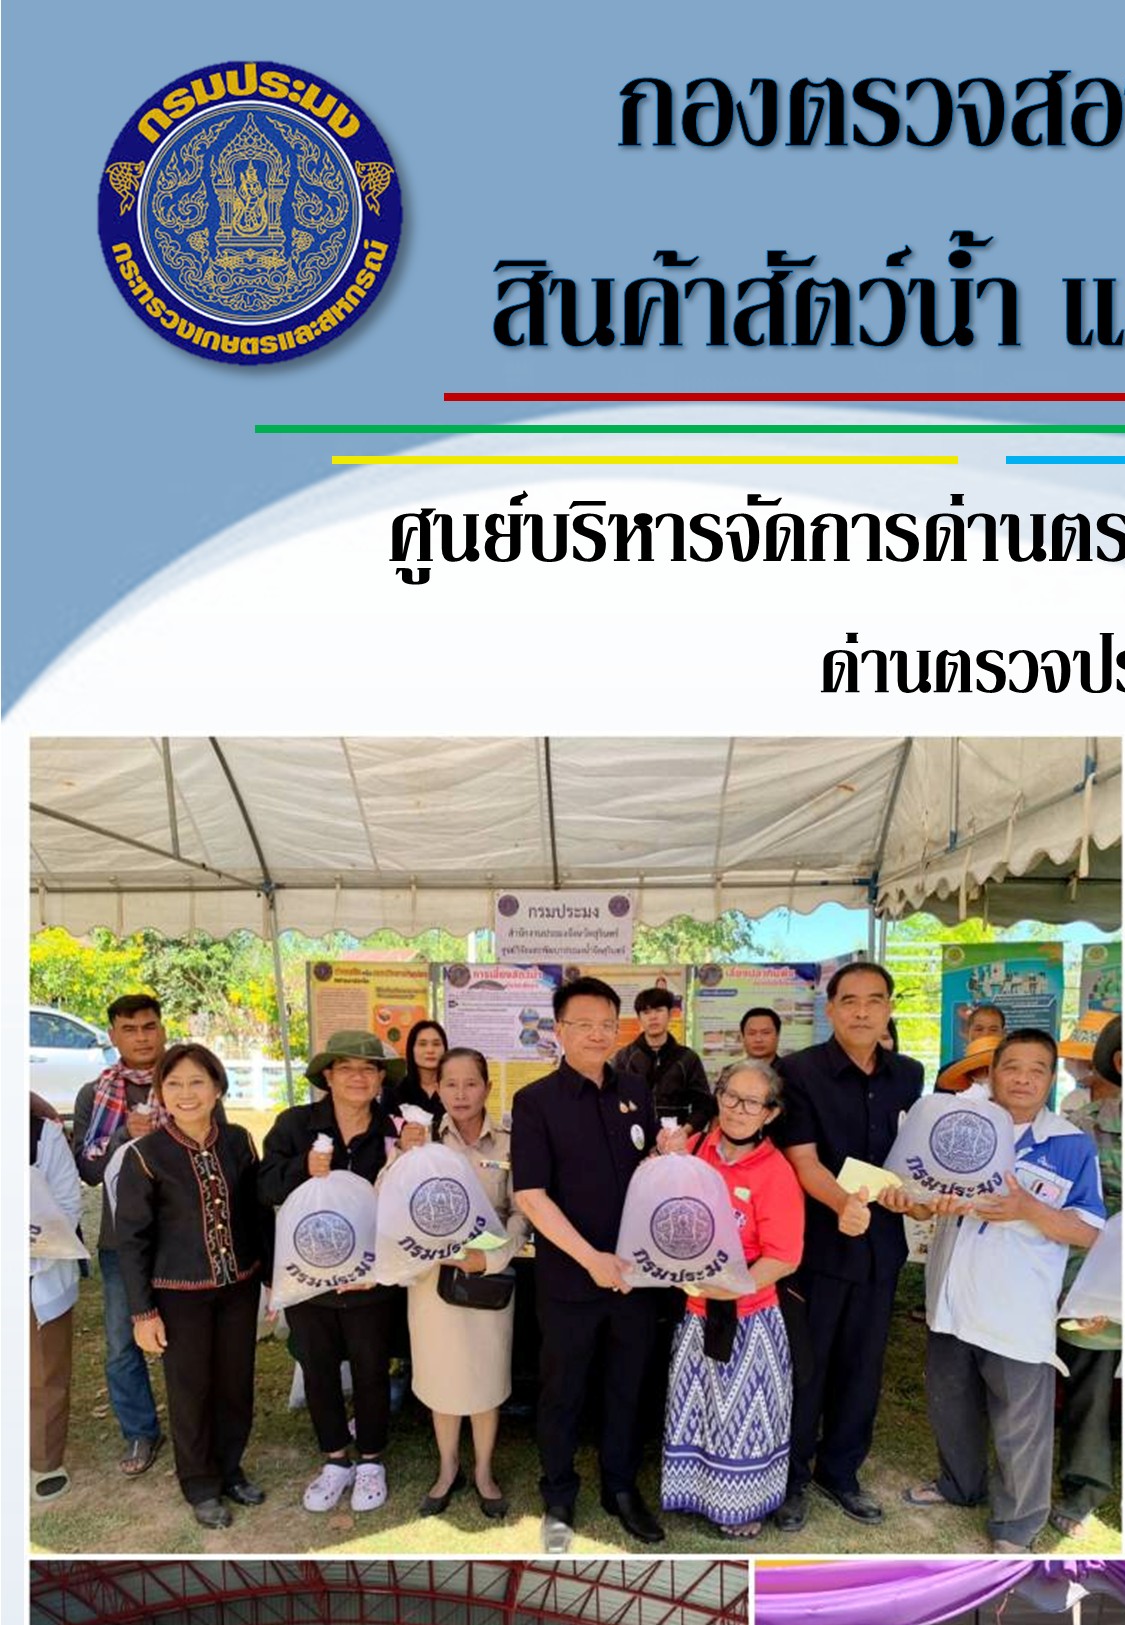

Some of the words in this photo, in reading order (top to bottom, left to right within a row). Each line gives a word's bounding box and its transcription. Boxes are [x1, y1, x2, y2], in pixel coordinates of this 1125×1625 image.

[528, 903, 600, 919] กรมประมง
[907, 1155, 1003, 1198] กรมประมง
[285, 1250, 377, 1288] กรมประมง
[632, 1248, 729, 1283] กรมประมง
